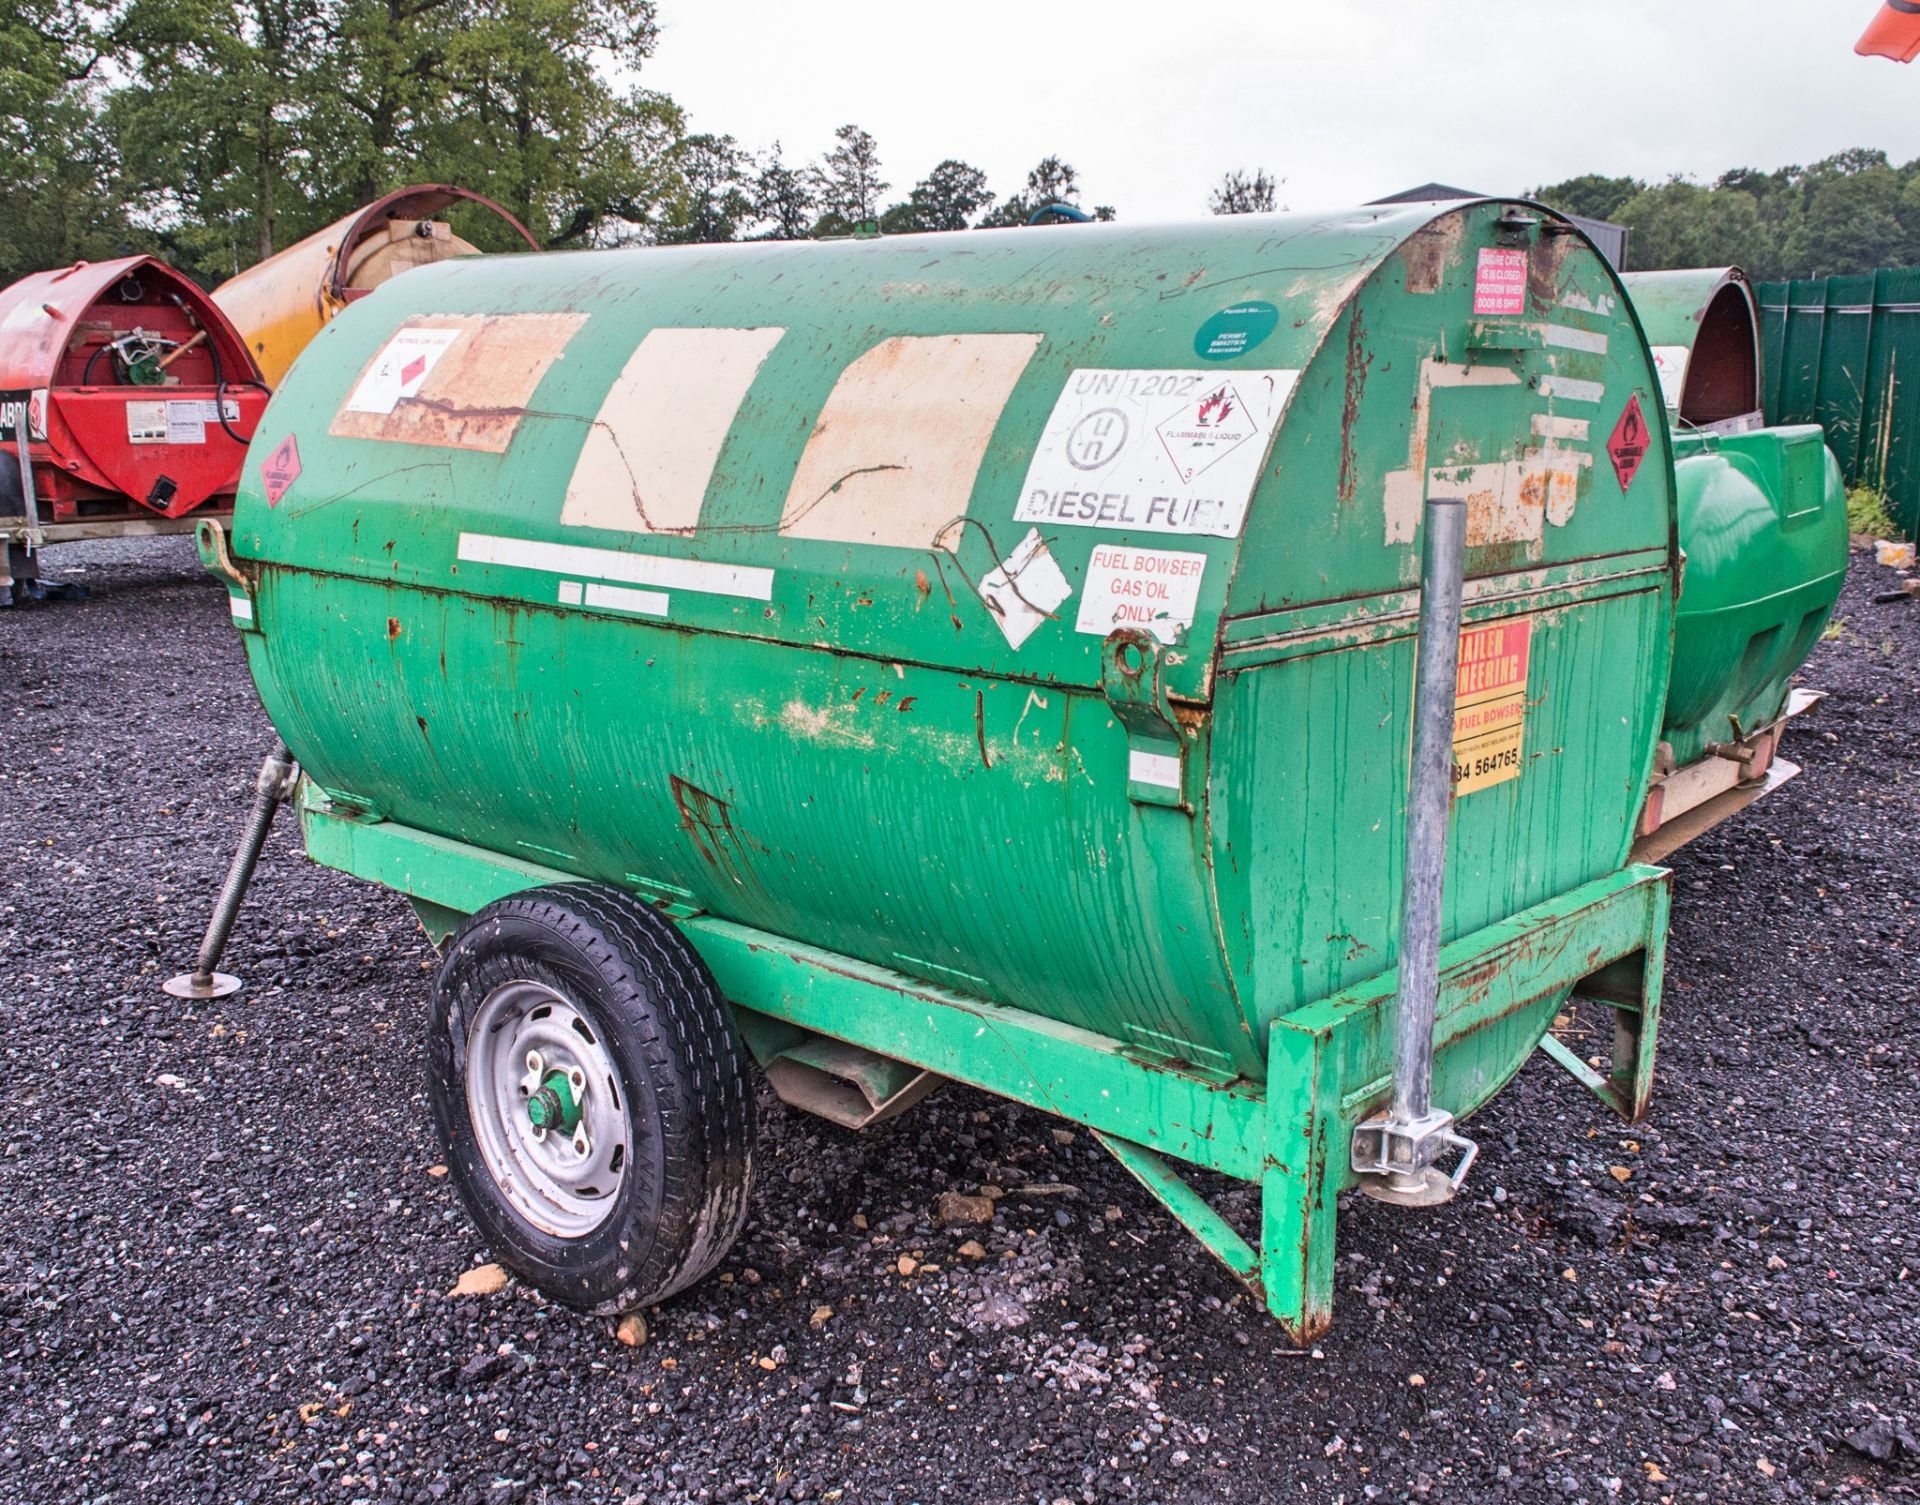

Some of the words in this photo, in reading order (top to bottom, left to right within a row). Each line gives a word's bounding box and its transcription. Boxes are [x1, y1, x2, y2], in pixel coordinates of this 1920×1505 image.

[1476, 284, 1504, 294] POSITION
[1505, 284, 1523, 295] WHEN
[1478, 298, 1495, 308] DOOR
[1496, 298, 1503, 308] IS
[1218, 332, 1247, 340] PERMIT
[1075, 374, 1119, 396] UN
[1128, 375, 1196, 397] 1202
[1166, 430, 1213, 440] FLAMMABLE
[1214, 432, 1243, 441] LIQUID
[1027, 488, 1136, 523] DIESEL
[1092, 551, 1129, 571] FUEL
[1133, 555, 1202, 578] BOWSER
[1110, 578, 1142, 595] GAS
[1145, 580, 1170, 600] OIL
[1116, 603, 1157, 622] ONLY
[1459, 714, 1481, 732] FUEL
[1484, 702, 1521, 724] BOWSER
[1475, 747, 1518, 777] 564765
